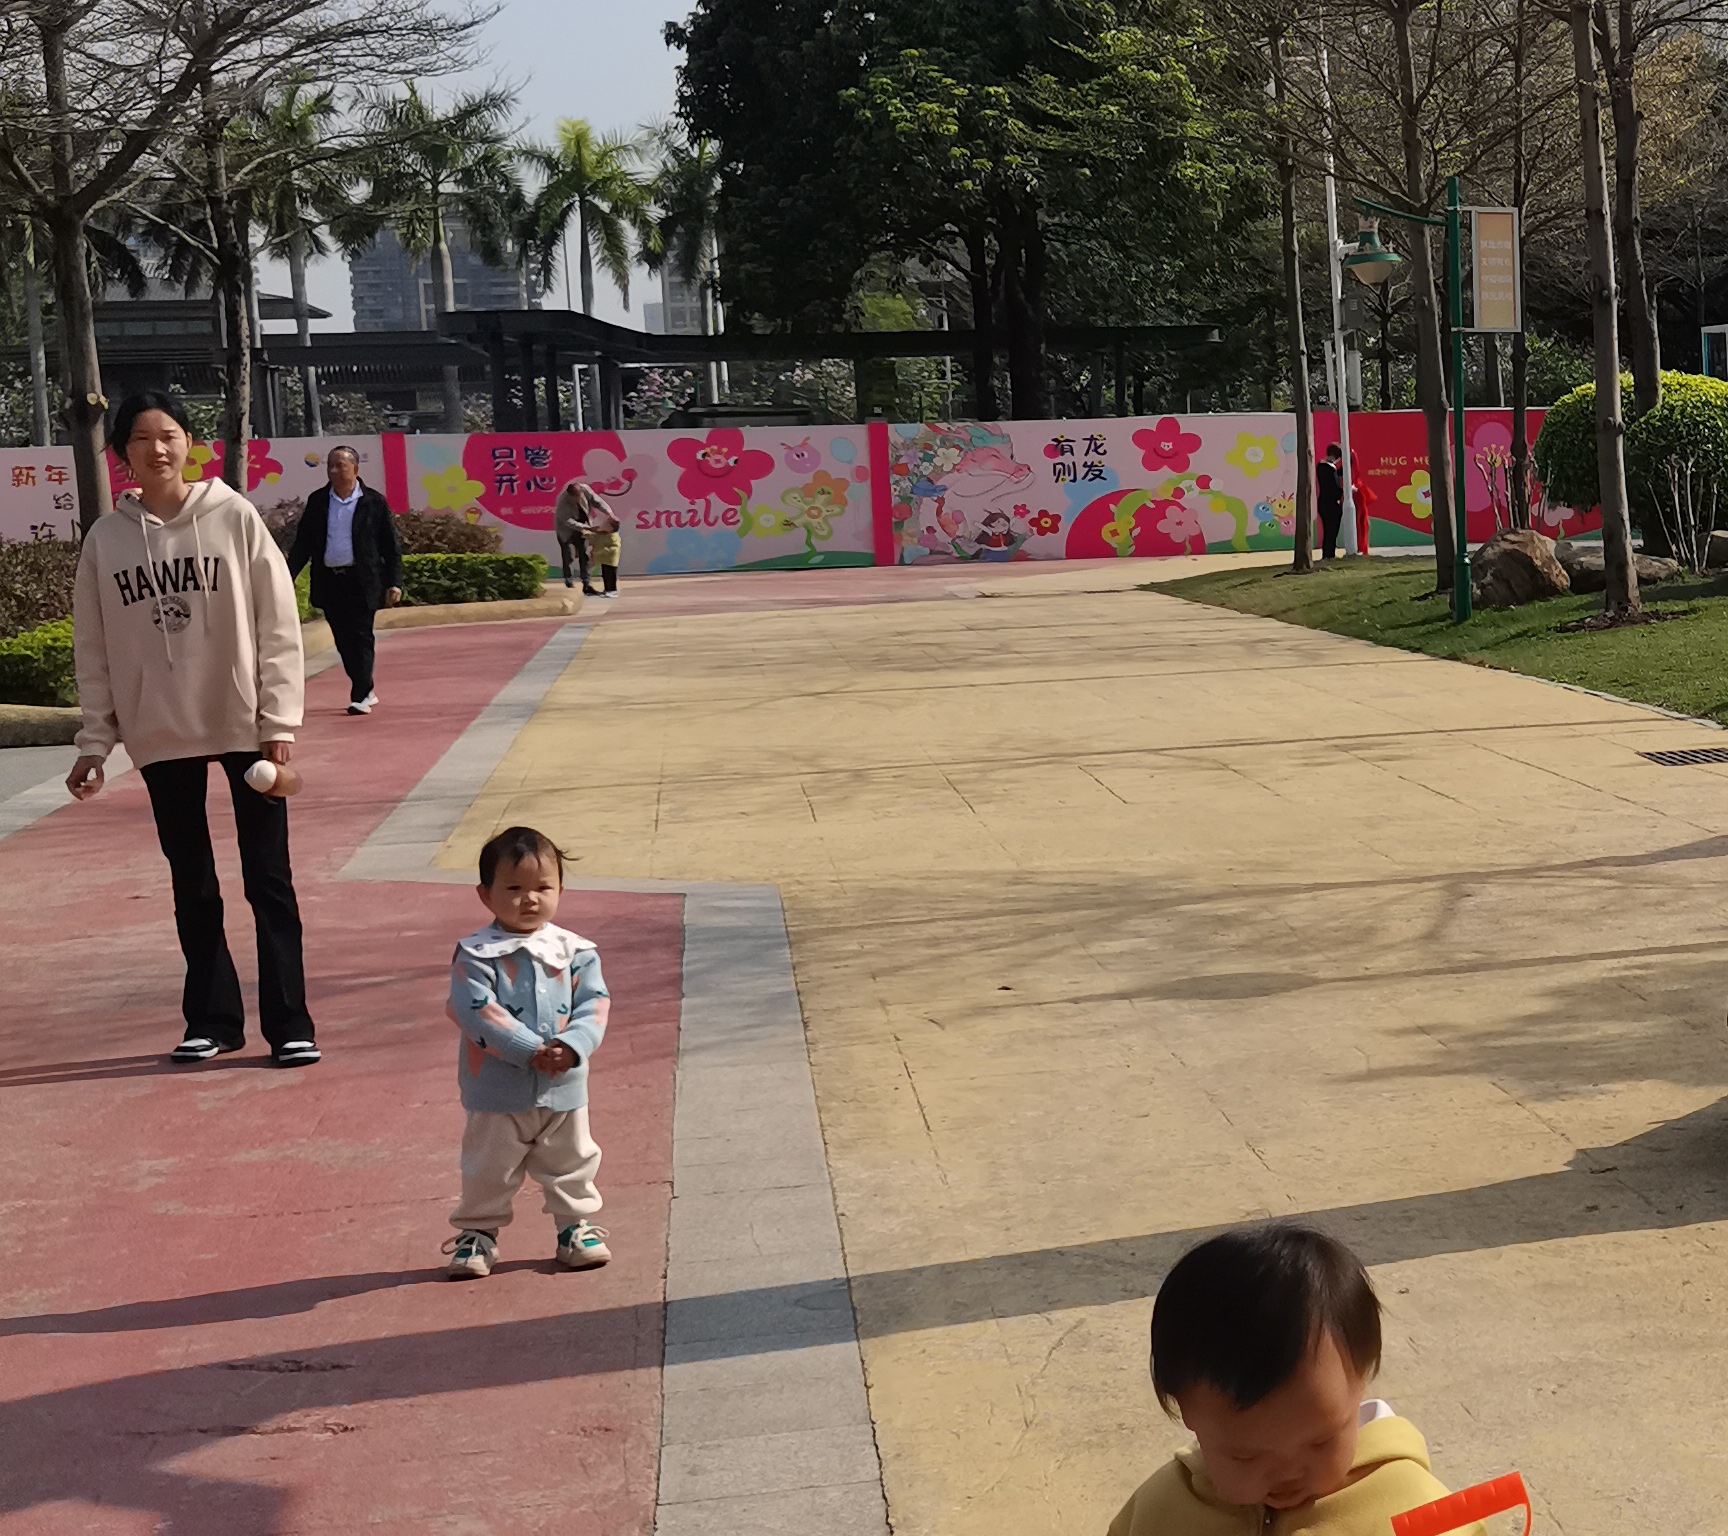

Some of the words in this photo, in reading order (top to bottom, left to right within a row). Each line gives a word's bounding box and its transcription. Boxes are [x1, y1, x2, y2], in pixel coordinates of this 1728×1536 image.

[1051, 434, 1107, 457] 有龙
[492, 445, 553, 470] 只管
[11, 465, 70, 487] 新年
[1053, 460, 1107, 483] 则发
[495, 473, 556, 496] 开心
[53, 492, 74, 510] 给
[635, 497, 741, 529] smile
[113, 556, 220, 607] HAWAII
